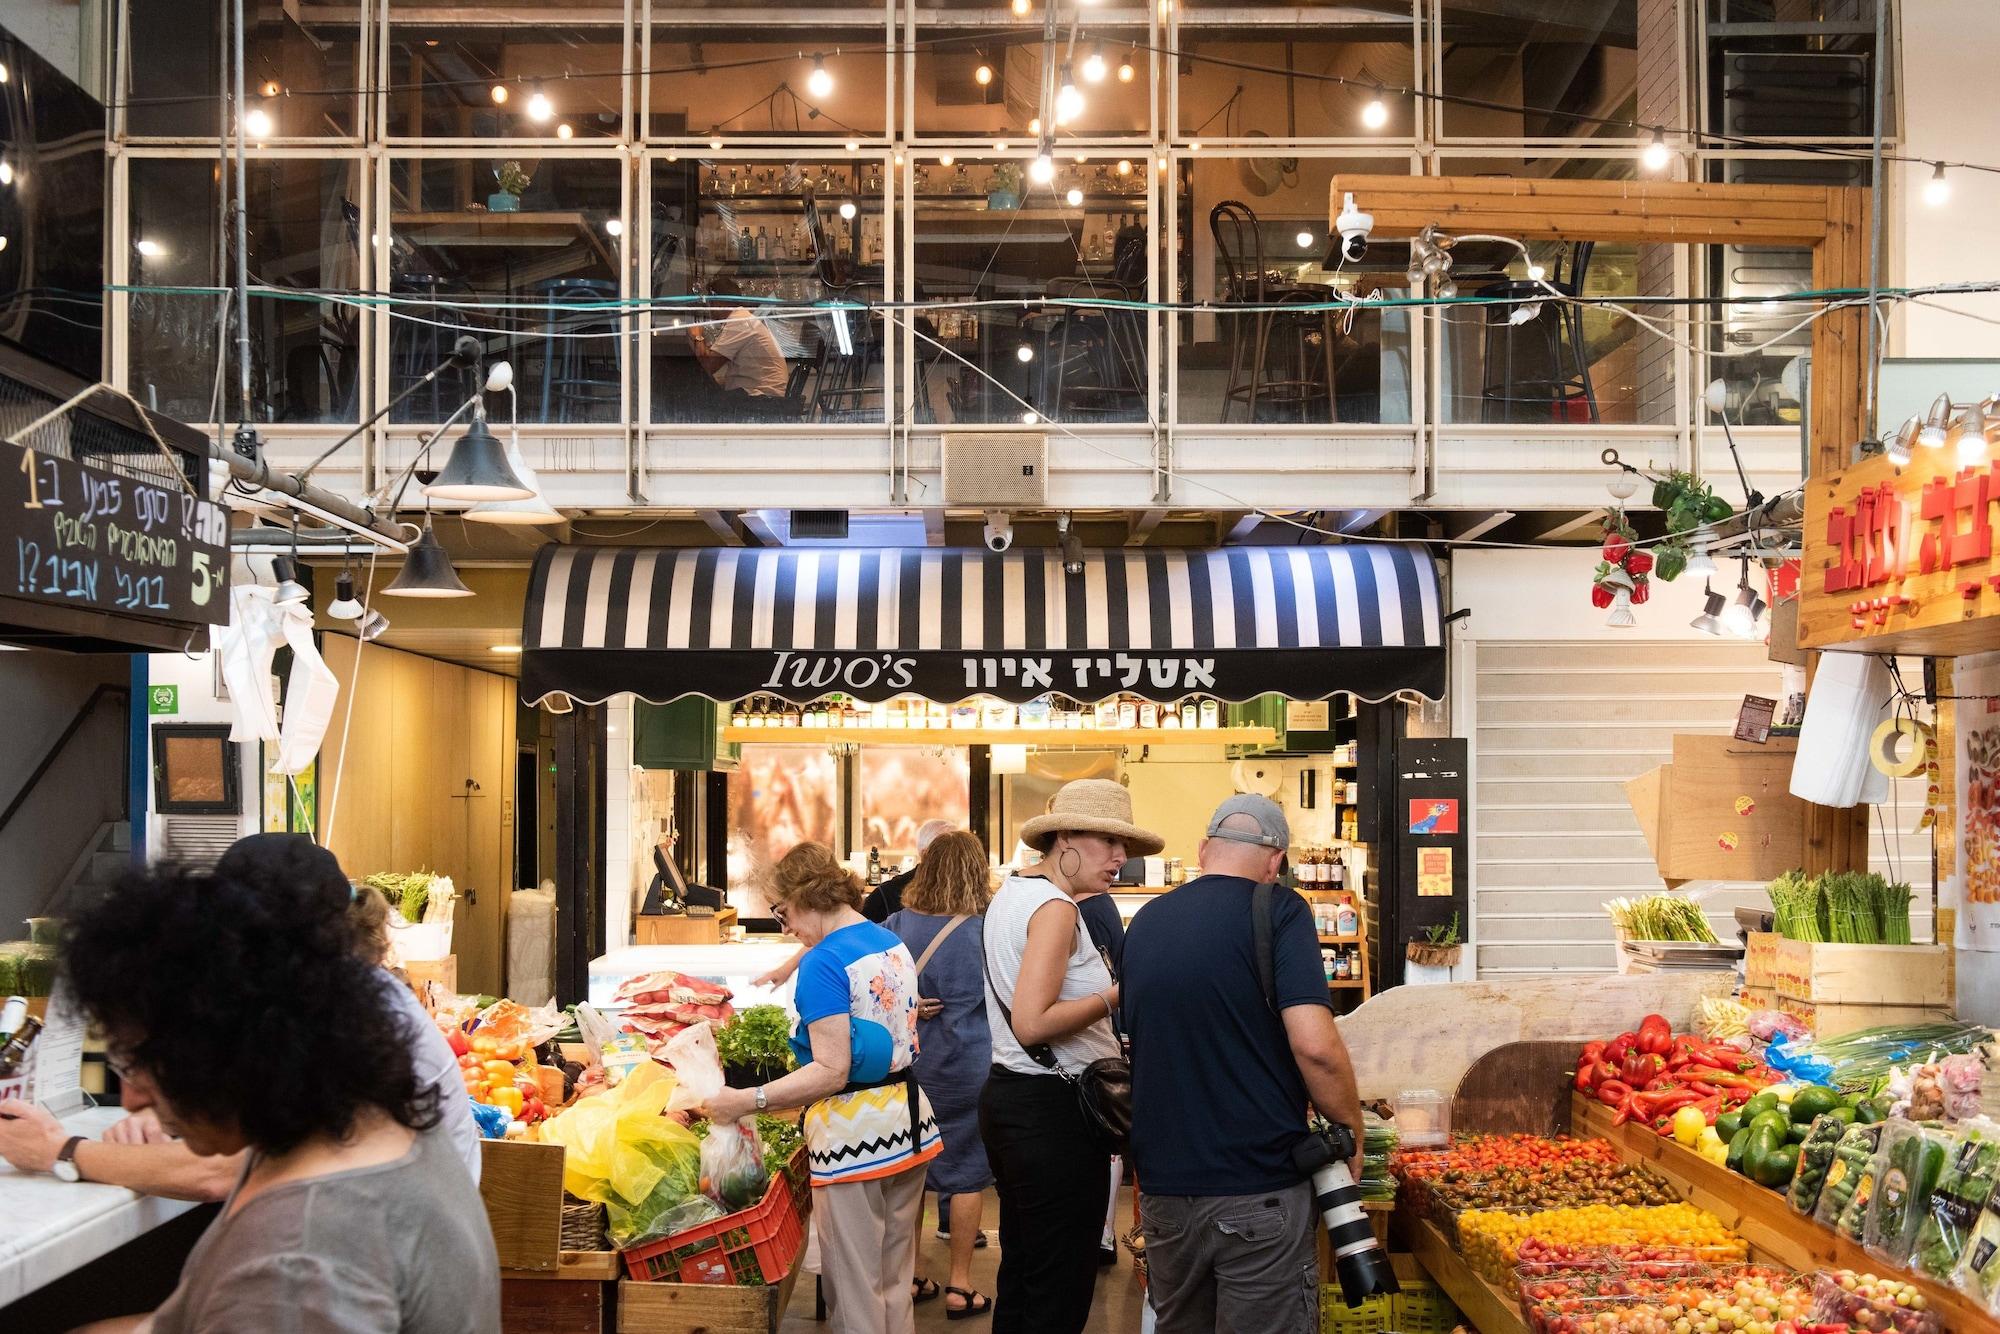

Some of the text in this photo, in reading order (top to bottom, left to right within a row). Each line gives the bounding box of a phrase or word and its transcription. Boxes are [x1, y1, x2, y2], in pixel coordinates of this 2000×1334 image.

[114, 566, 170, 609] בתל
[761, 651, 918, 688] Iwo's
[962, 651, 1217, 688] אטליז איוו
